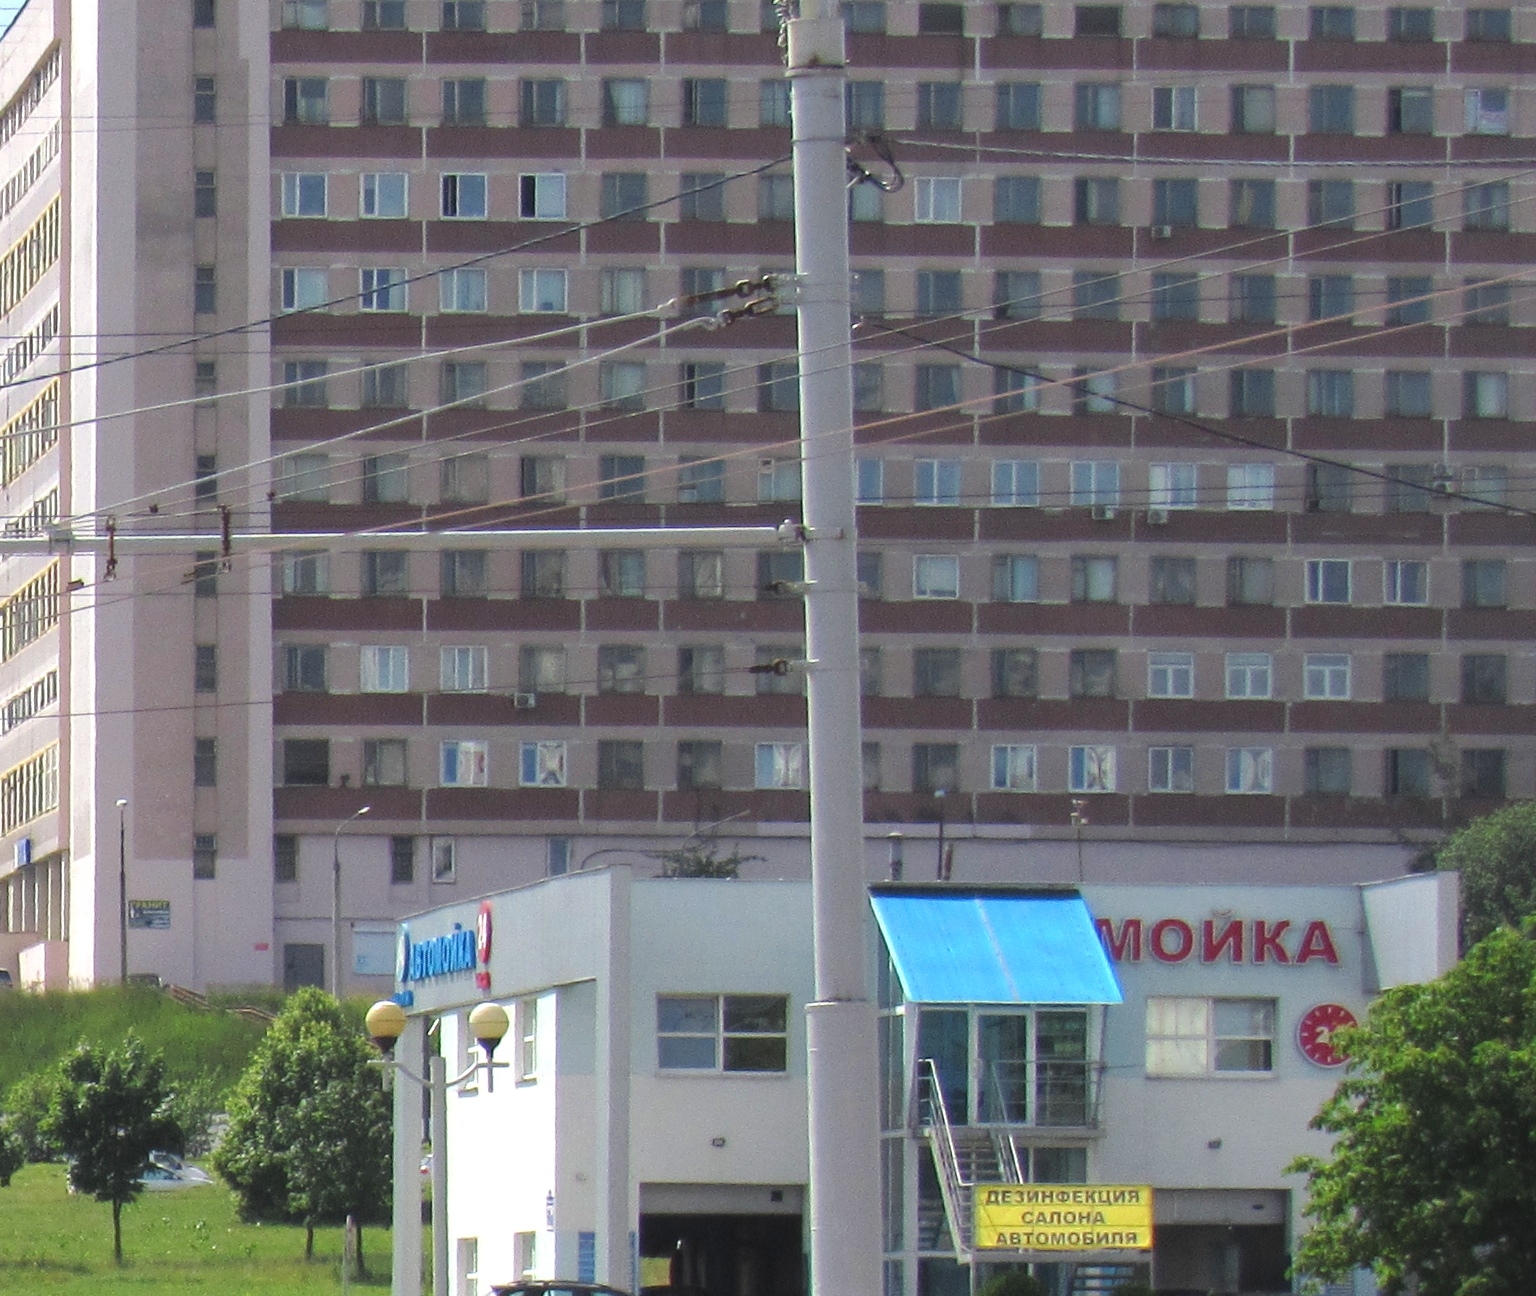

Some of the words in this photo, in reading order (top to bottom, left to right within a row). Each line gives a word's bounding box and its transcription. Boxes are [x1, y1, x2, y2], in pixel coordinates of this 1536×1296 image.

[1095, 908, 1340, 965] МОЙКА
[986, 1189, 1140, 1206] ДЕЗИНФЕКЦИЯ
[1021, 1211, 1106, 1225] САЛОНА
[995, 1232, 1138, 1246] АВТОМОБИЛЯ
